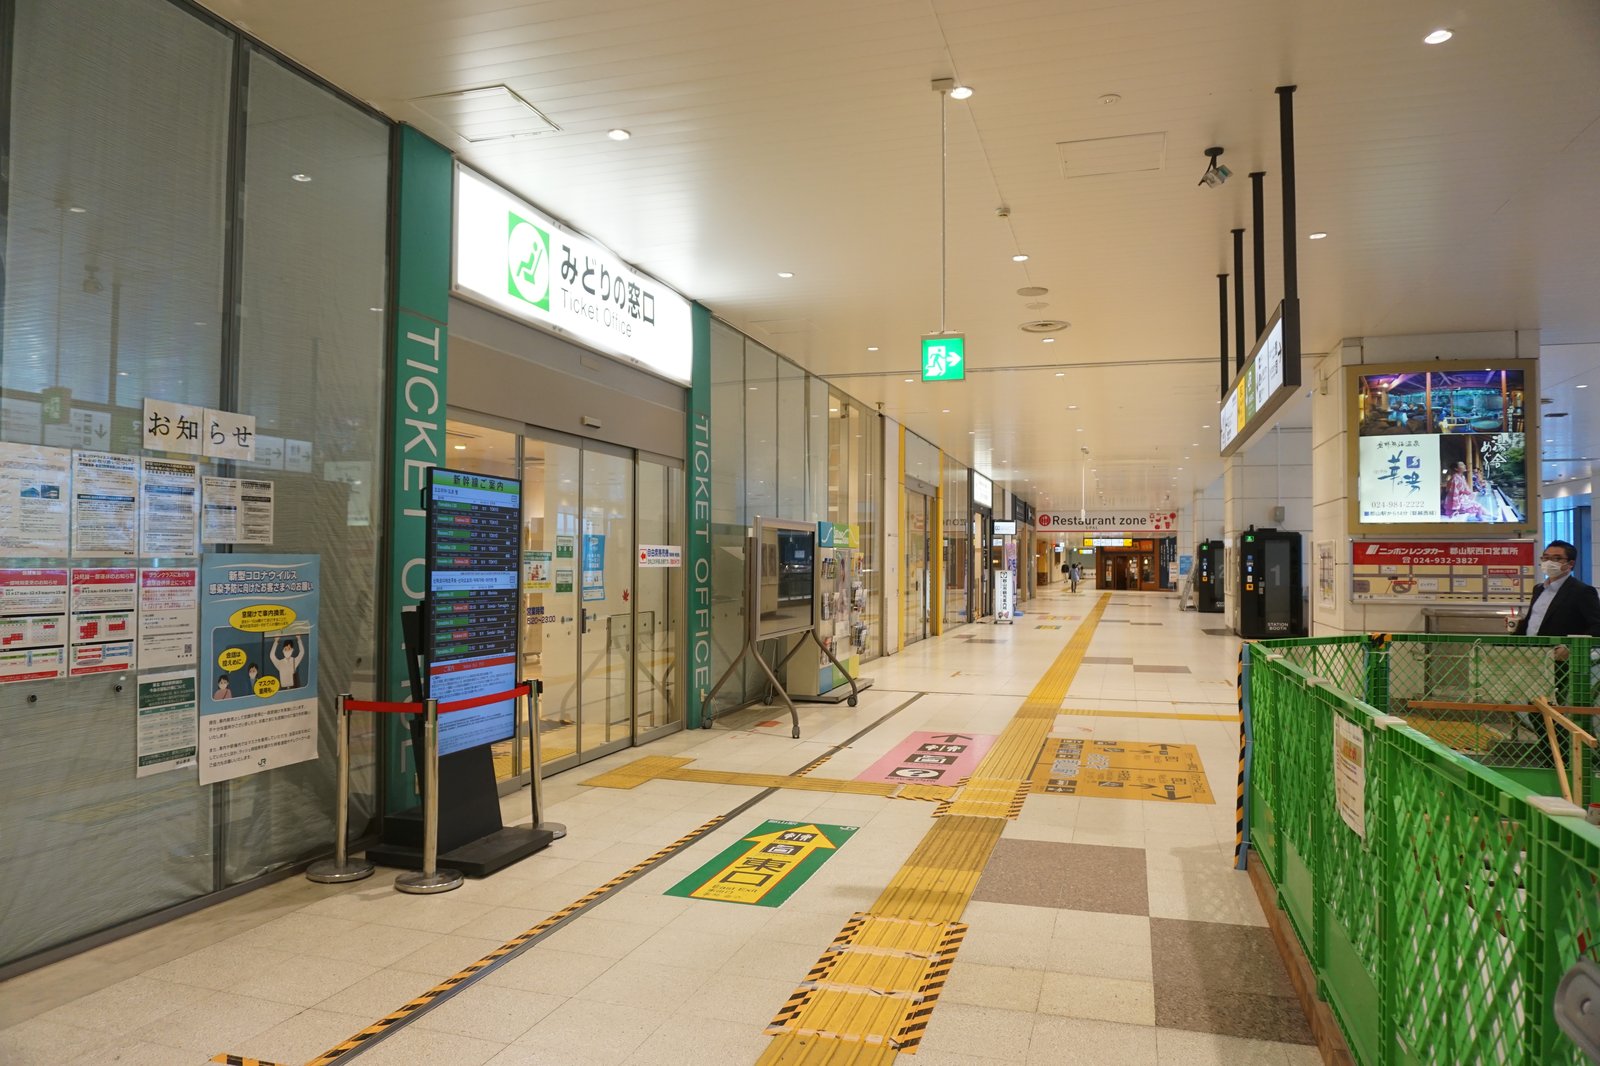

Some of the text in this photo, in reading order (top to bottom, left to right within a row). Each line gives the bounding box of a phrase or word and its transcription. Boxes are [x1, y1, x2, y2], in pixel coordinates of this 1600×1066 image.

[560, 244, 656, 327] みどりの窓口
[560, 288, 633, 339] Ticket Office
[147, 411, 253, 448] お知らせ
[453, 474, 504, 492] 新幹線ご案内
[1052, 515, 1147, 525] Restaurant zone
[694, 419, 710, 689] TICKET OFFICE
[1378, 547, 1519, 556] ニッポンレンタカー 郡山駅西口営業所
[228, 569, 297, 582] 新型コロナウイルス
[208, 581, 314, 596] 感染予防に向けたお客さまへのお願い
[257, 758, 267, 766] JR
[718, 857, 792, 888] 東口
